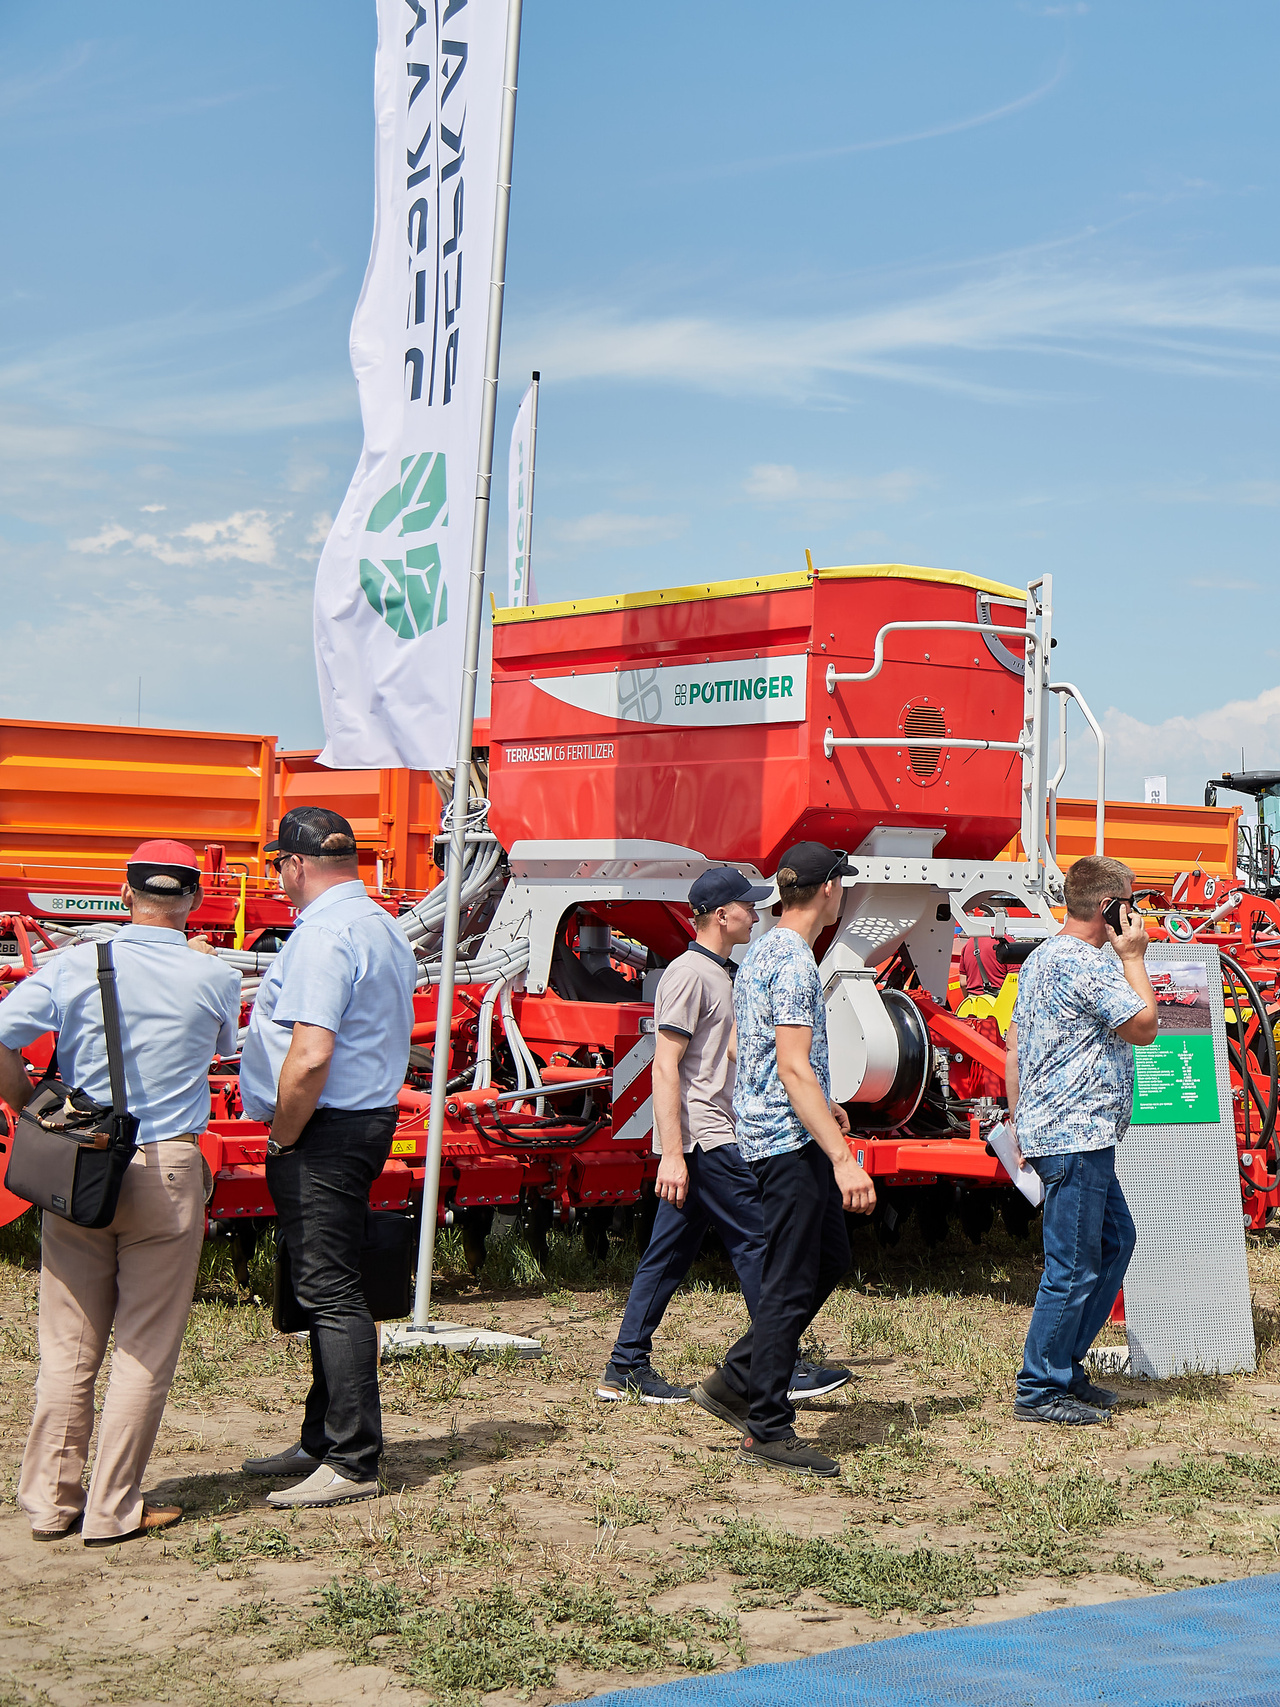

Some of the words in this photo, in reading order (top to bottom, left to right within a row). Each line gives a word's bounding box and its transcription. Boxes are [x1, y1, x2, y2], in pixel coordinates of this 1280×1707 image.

[689, 675, 794, 704] PÖTTINGER
[505, 746, 553, 763] TERRASEM
[554, 745, 566, 761] C6
[567, 743, 615, 761] FERTILIZER
